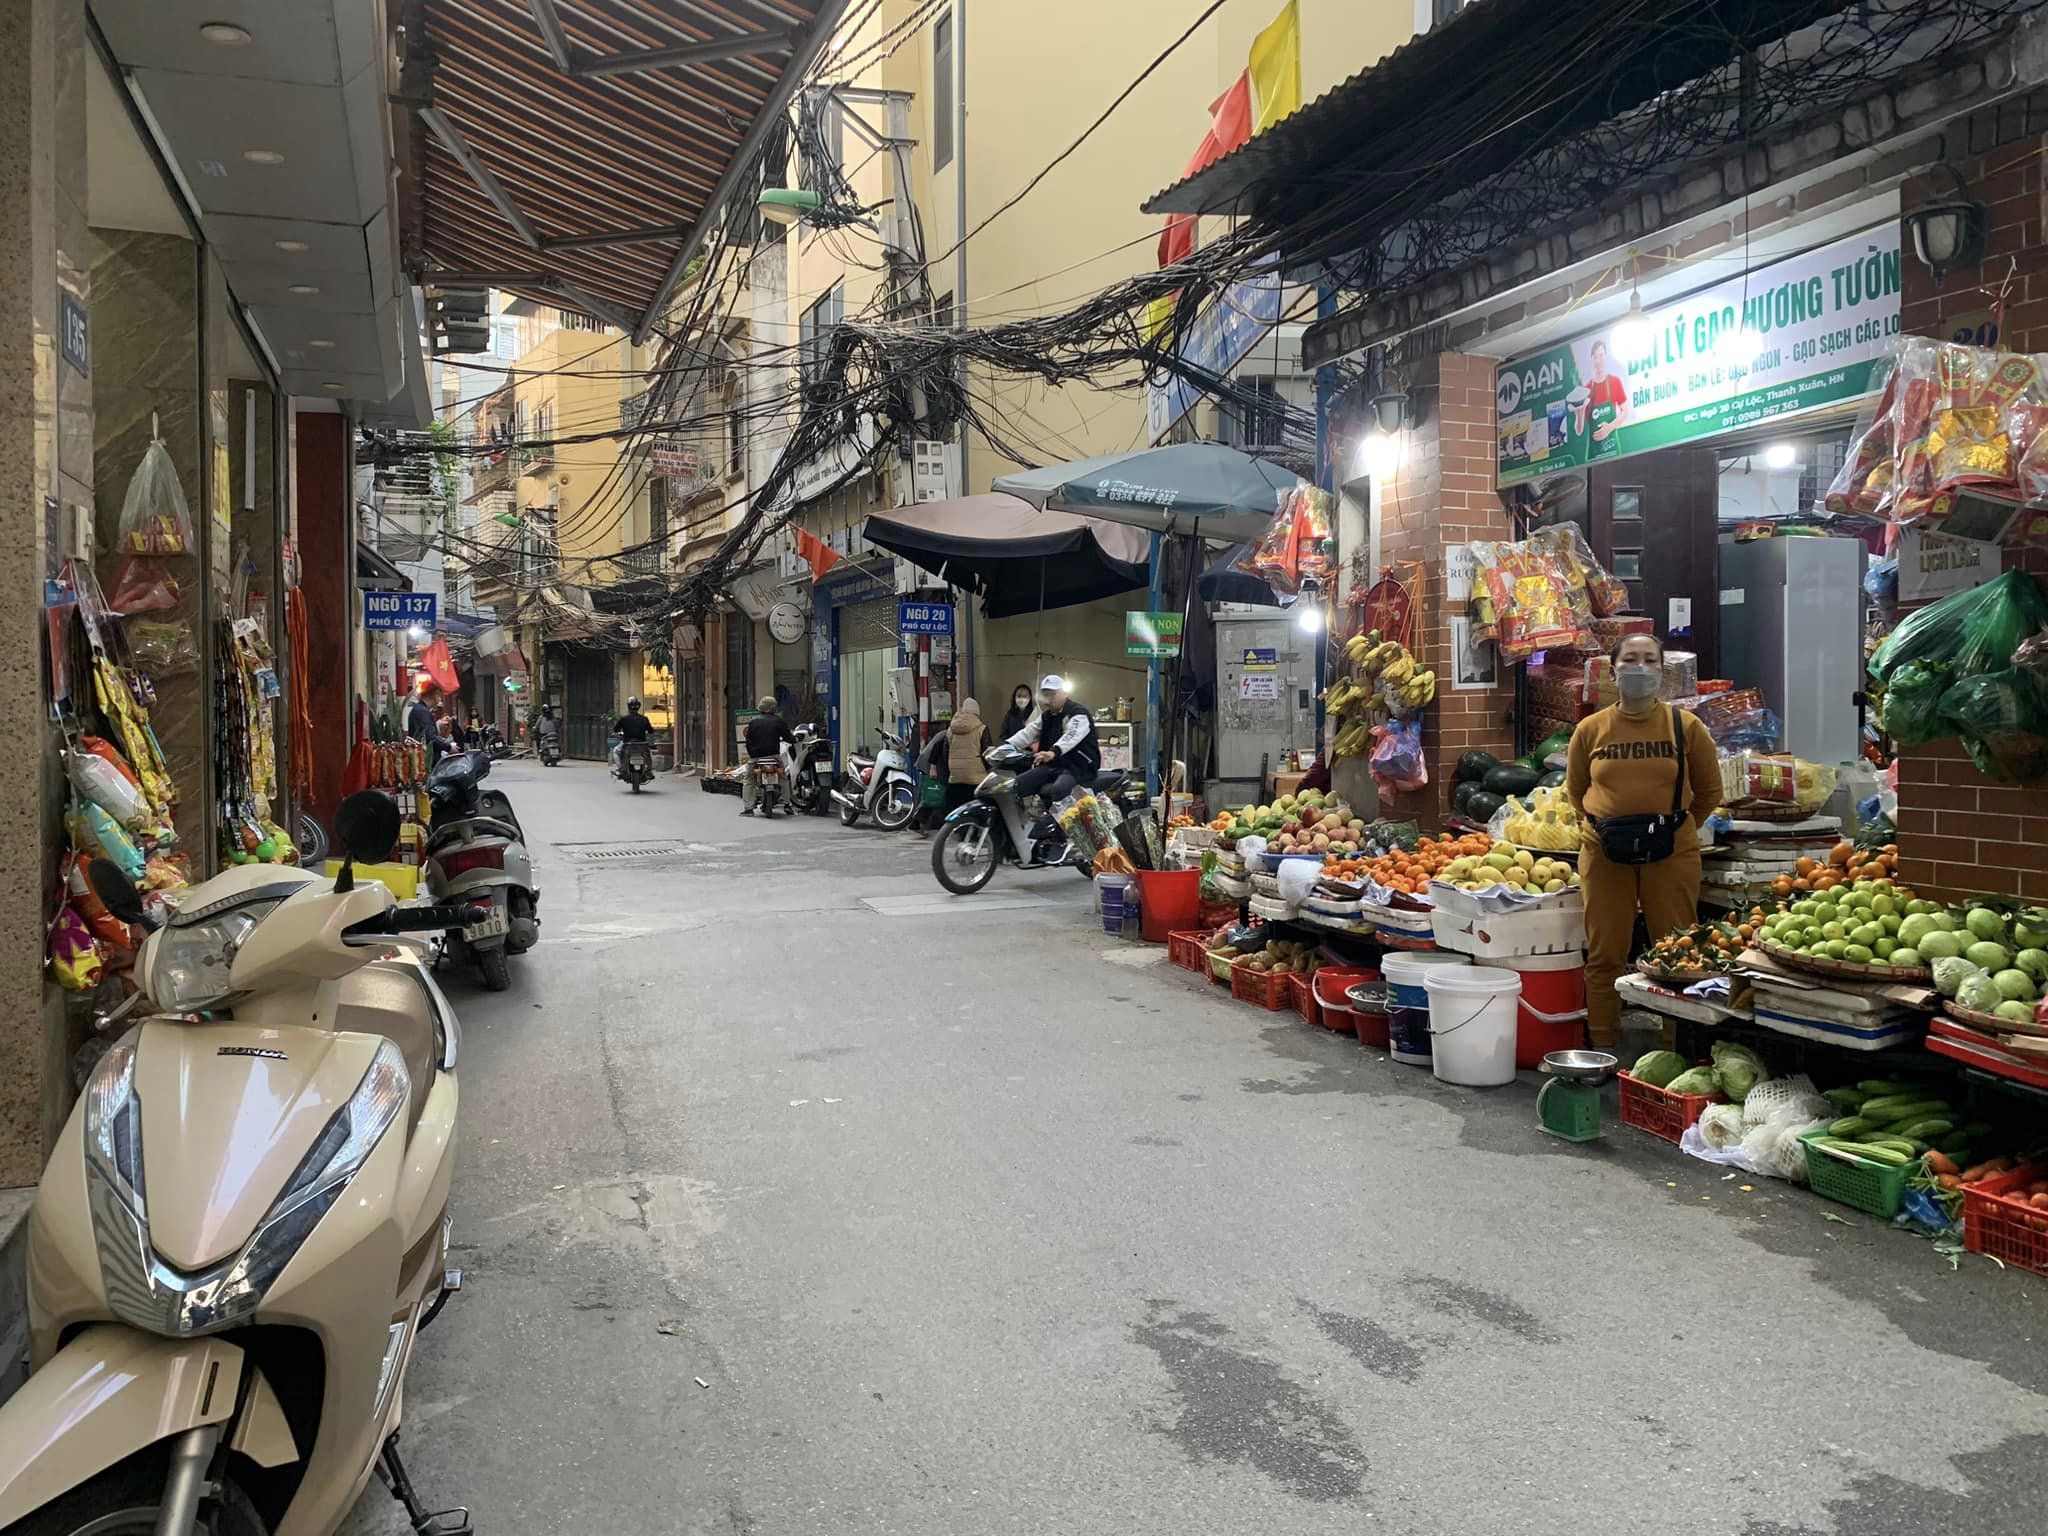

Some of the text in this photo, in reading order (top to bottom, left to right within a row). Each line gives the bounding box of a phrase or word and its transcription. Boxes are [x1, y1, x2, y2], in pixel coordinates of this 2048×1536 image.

[1666, 314, 1686, 363] LÝ
[1743, 275, 1823, 333] HƯƠNG
[67, 306, 86, 363] 135
[1793, 338, 1816, 366] GẠO
[1820, 328, 1852, 356] SẠCH
[1856, 318, 1880, 344] CÁC
[1766, 385, 1797, 402] Thanh
[1828, 372, 1845, 384] HN
[368, 594, 432, 612] NGÕ 137
[906, 606, 946, 621] NGÕ 20
[368, 616, 391, 626] PHỐ
[393, 618, 409, 628] CỰ
[902, 621, 919, 630] PHỐ
[1157, 618, 1179, 631] NON
[217, 1046, 289, 1061] HONDA
